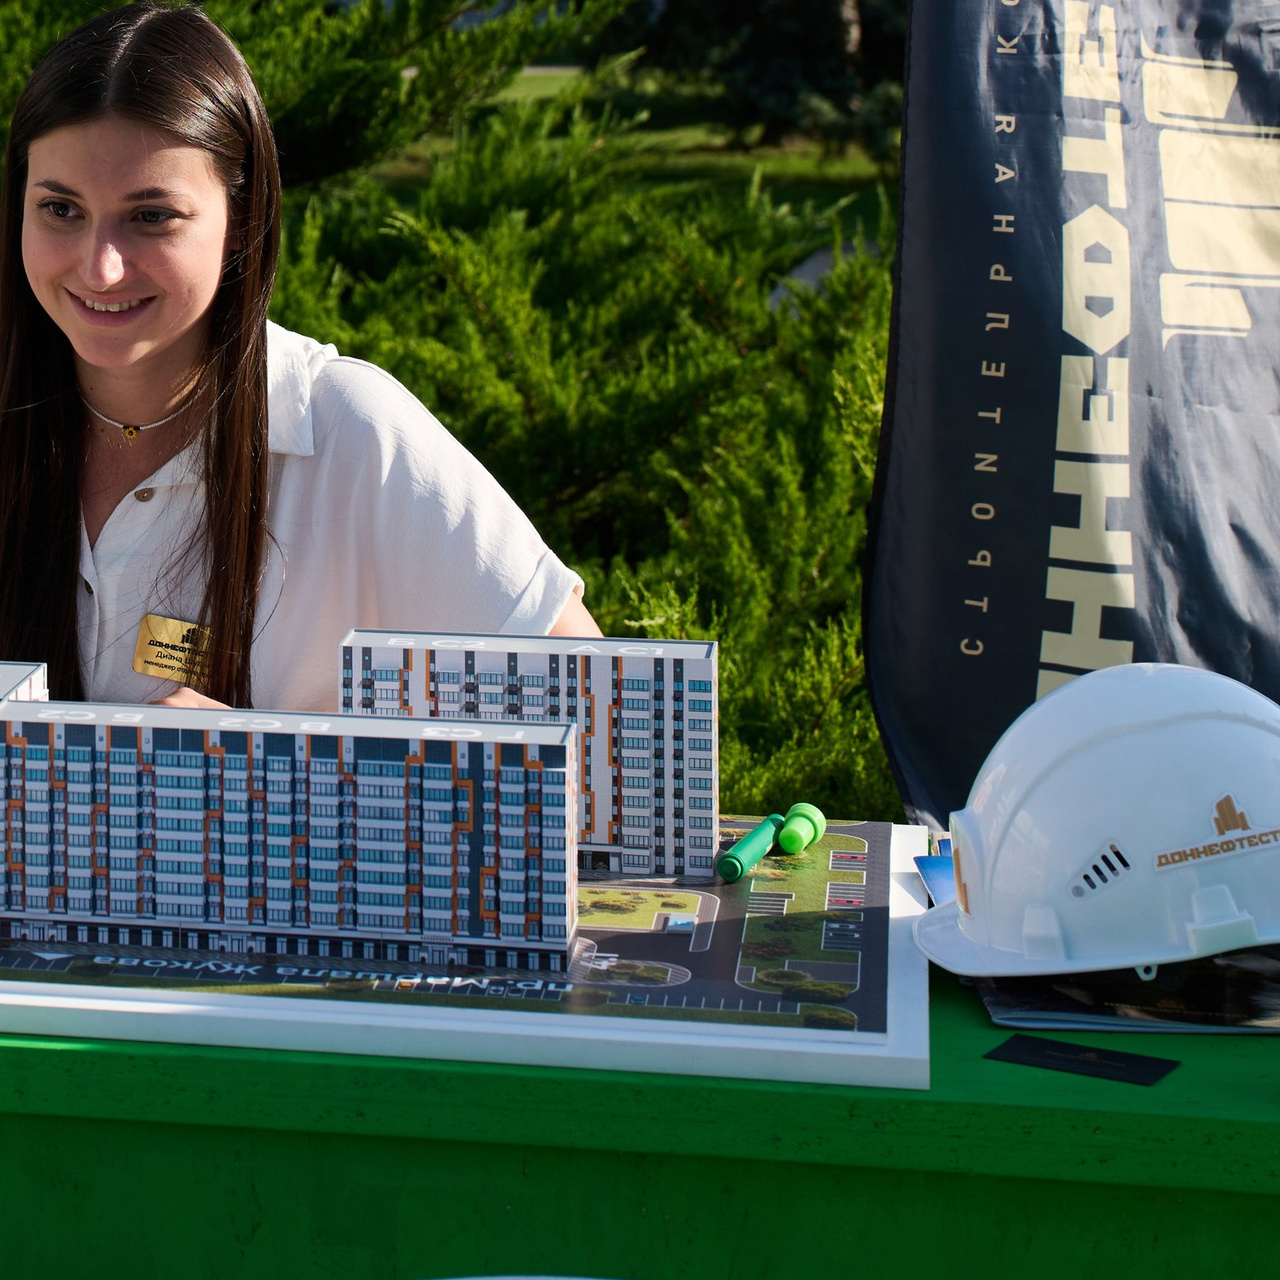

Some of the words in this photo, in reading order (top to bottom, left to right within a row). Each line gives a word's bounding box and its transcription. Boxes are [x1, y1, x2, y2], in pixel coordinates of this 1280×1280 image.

[155, 650, 183, 663] Диана
[143, 659, 177, 672] менеджер
[1157, 829, 1280, 868] ДОННЕФТЕСТ
[93, 955, 265, 976] Жукова
[276, 966, 489, 990] Маршала
[508, 978, 574, 992] пр.
